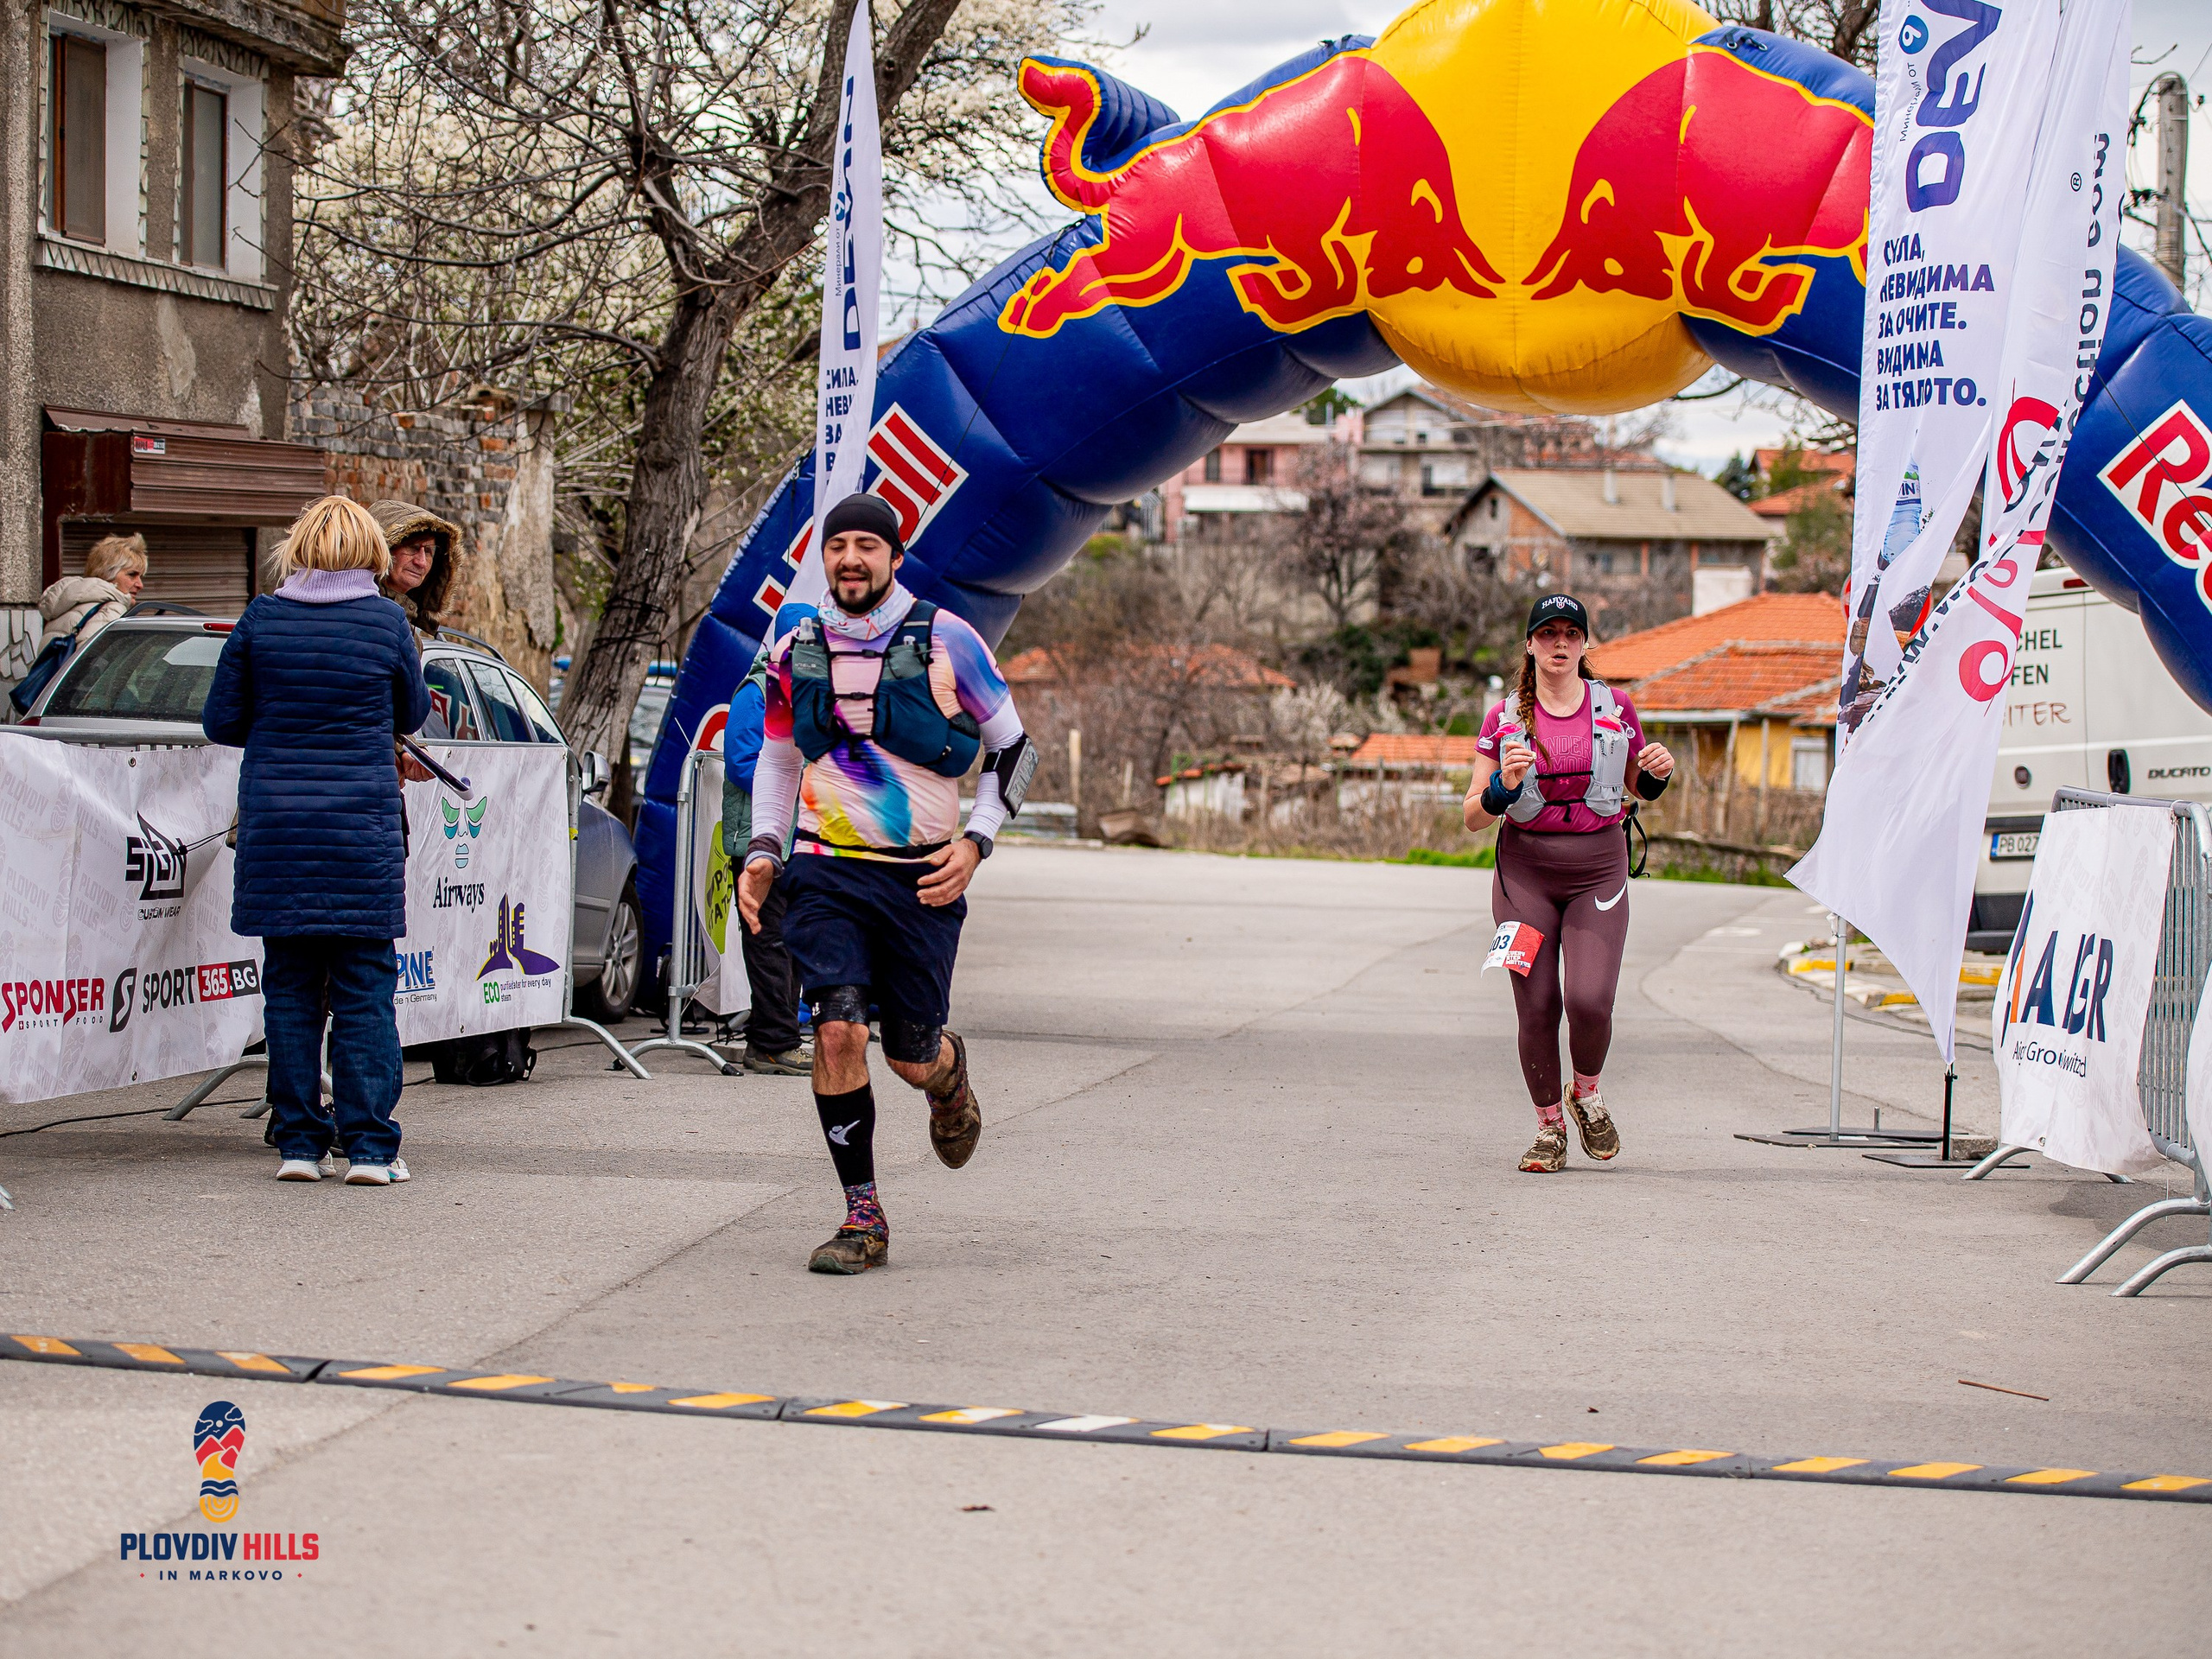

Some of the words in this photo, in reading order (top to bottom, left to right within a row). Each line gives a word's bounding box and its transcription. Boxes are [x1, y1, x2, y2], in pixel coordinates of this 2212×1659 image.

[1880, 264, 1994, 302] НЕВИДИМА
[1878, 311, 1894, 339] ЗА
[1896, 302, 1967, 334] ОЧИТЕ.
[1877, 340, 1944, 377] ВИДИМА
[1876, 384, 1890, 411] ЗА
[1541, 596, 1578, 611] HARVARD
[2003, 701, 2071, 728] ITER
[2148, 766, 2211, 779] DUCATO
[1999, 836, 2015, 853] PB
[433, 876, 485, 914] Airways
[1489, 935, 1510, 952] 03
[142, 965, 196, 1014] SPORT
[483, 982, 500, 1003] ECO
[541, 977, 551, 988] day
[2, 977, 105, 1033] SPONSER
[410, 993, 437, 1002] Germany
[26, 1019, 59, 1028] SPORT
[75, 1015, 104, 1026] FOOD
